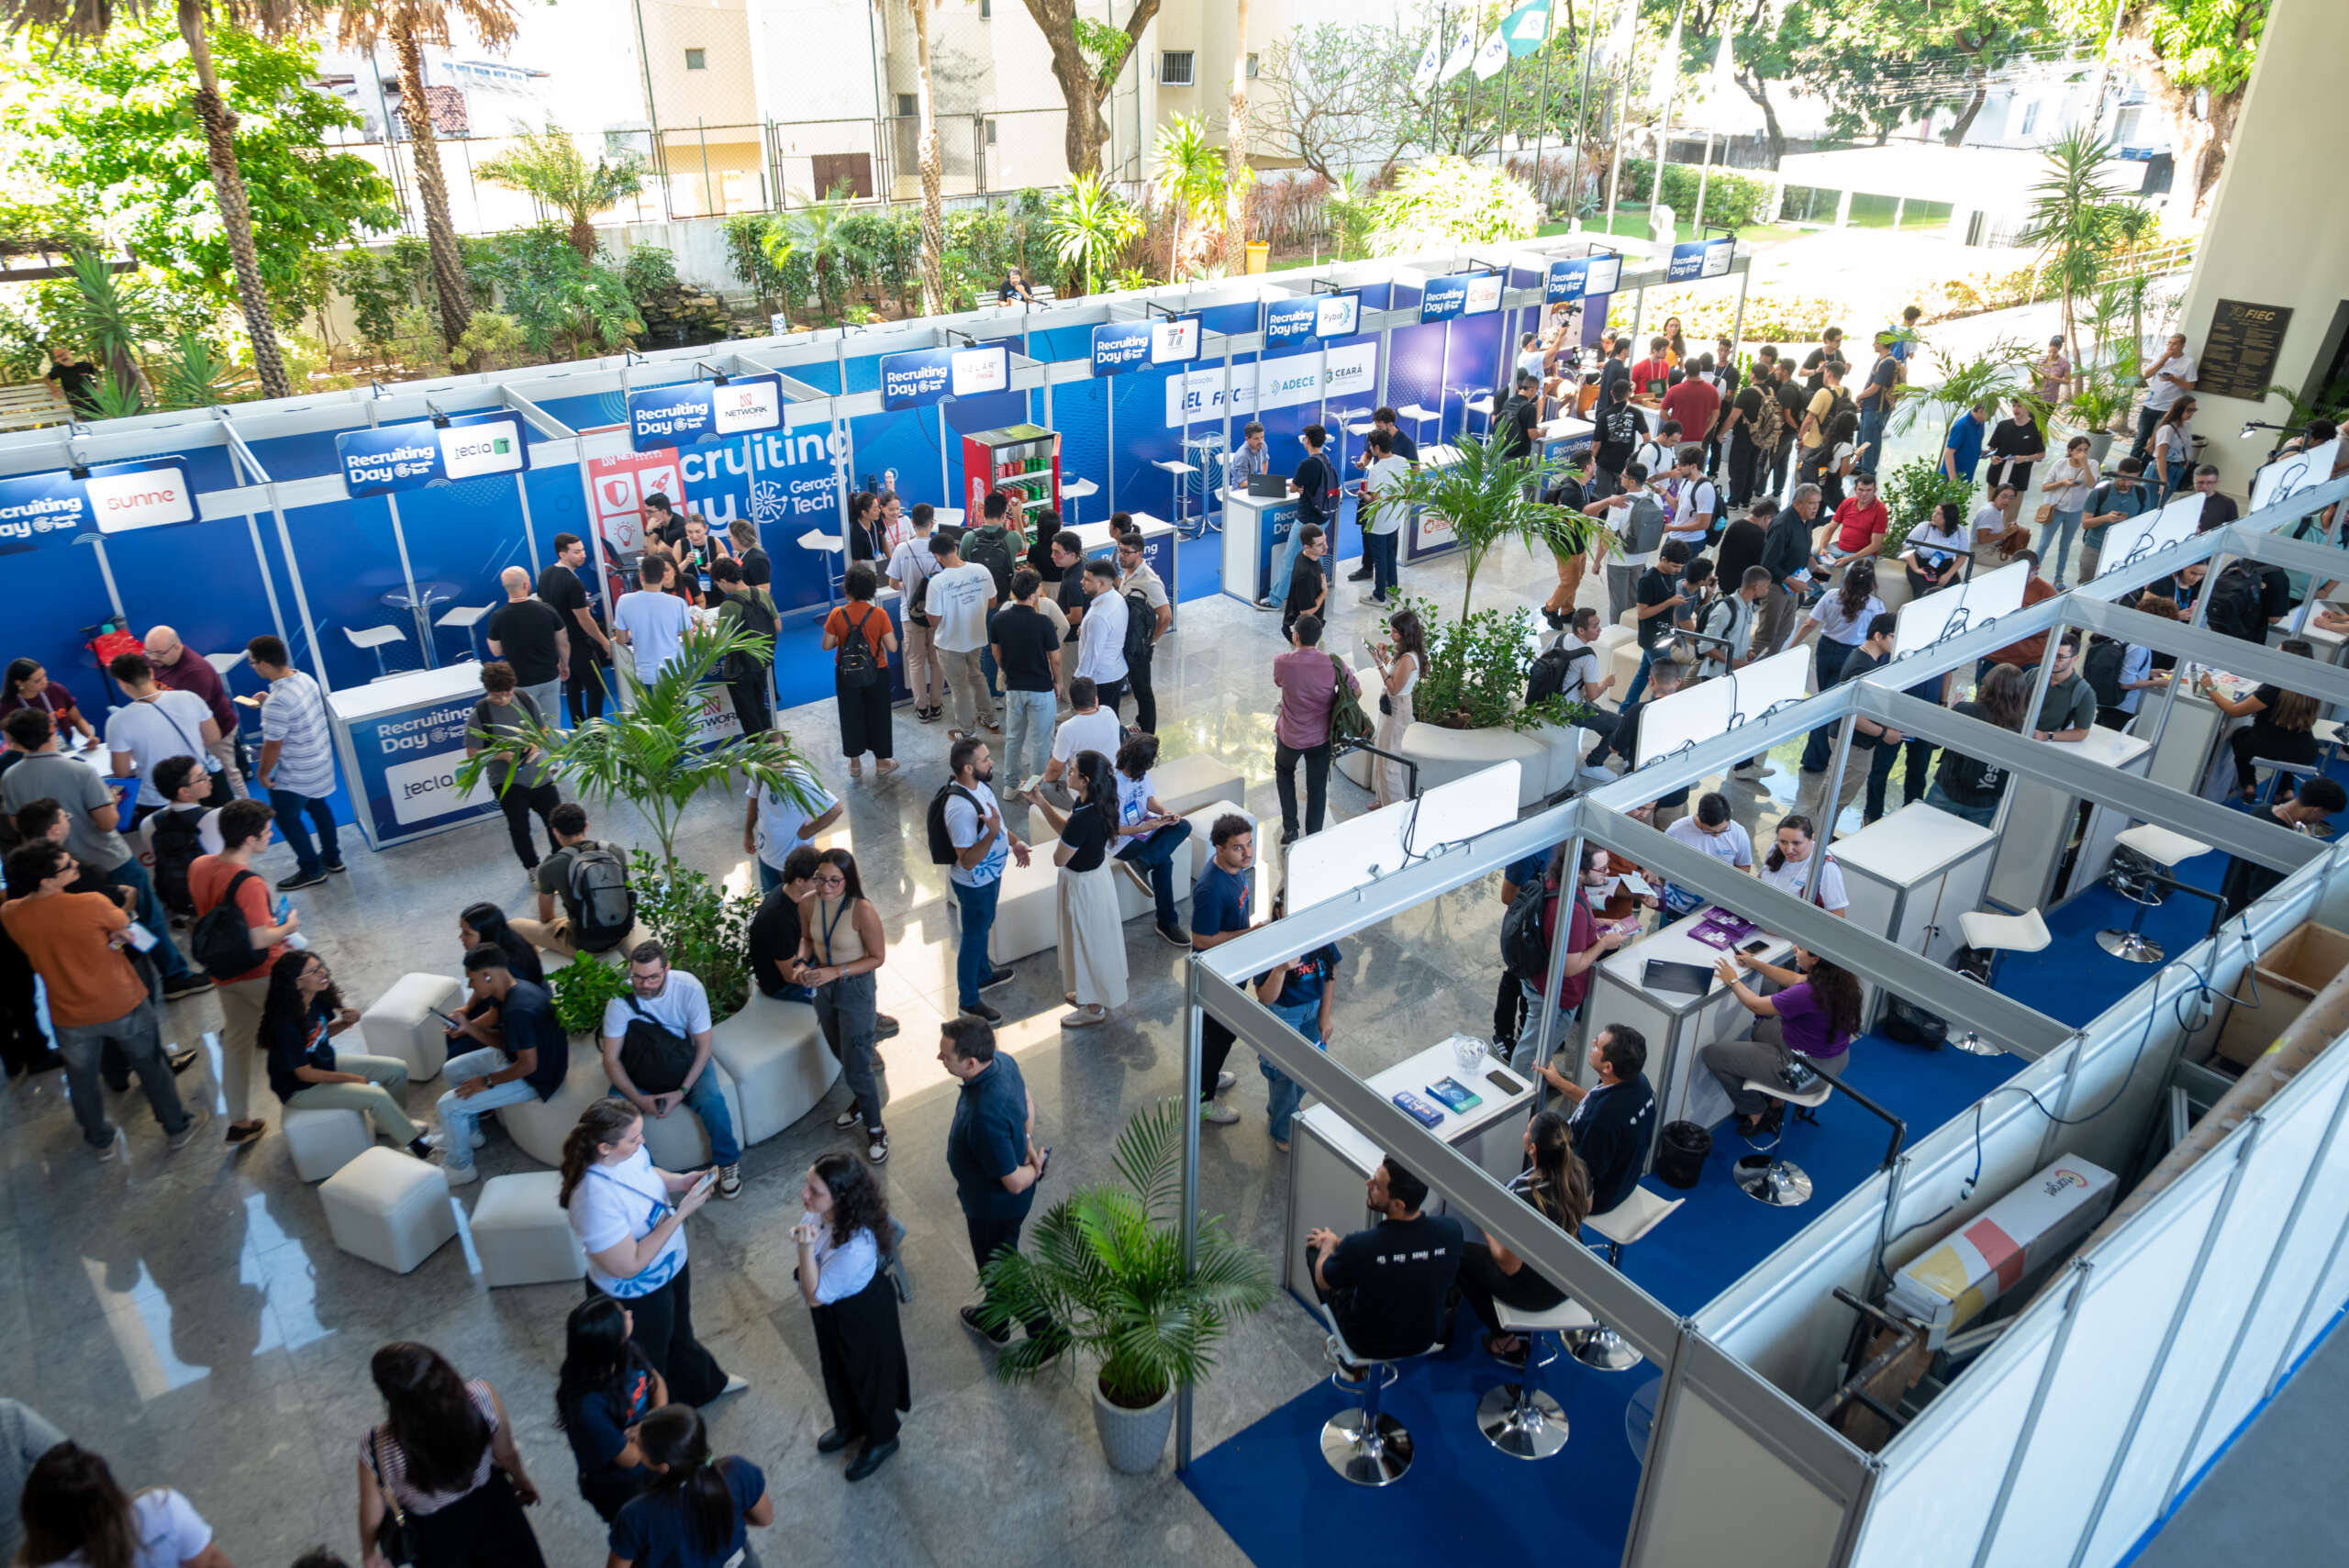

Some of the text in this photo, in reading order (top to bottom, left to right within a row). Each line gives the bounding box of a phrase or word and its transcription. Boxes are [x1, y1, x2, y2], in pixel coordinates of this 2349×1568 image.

[1551, 272, 1586, 283] Recruiting
[1670, 266, 1686, 275] Day
[1426, 288, 1465, 302] Recruiting
[1549, 283, 1566, 294] Day
[1270, 310, 1315, 324] Recruiting
[1424, 303, 1443, 314] Day
[2245, 309, 2276, 321] FIEC
[1269, 324, 1291, 337] Day
[1097, 335, 1149, 351] Recruiting
[1097, 351, 1122, 364] Day
[886, 366, 948, 384] Recruiting
[1282, 375, 1315, 391] ADECE
[1335, 363, 1363, 377] CEARÁ
[887, 384, 917, 396] Day
[635, 402, 708, 421] Recruiting
[725, 405, 767, 417] NETWORK
[637, 421, 673, 436] Day
[346, 446, 436, 468] Recruiting
[454, 442, 492, 460] tecla
[679, 427, 849, 483] cruiting
[350, 466, 394, 484] Day
[0, 497, 83, 519] cruiting
[106, 489, 176, 511] sunne
[791, 491, 834, 515] Tech
[0, 520, 32, 539] ay
[1274, 522, 1292, 535] Da
[377, 706, 474, 739] Recruiting
[380, 734, 429, 755] Day
[404, 774, 454, 800] tecla
